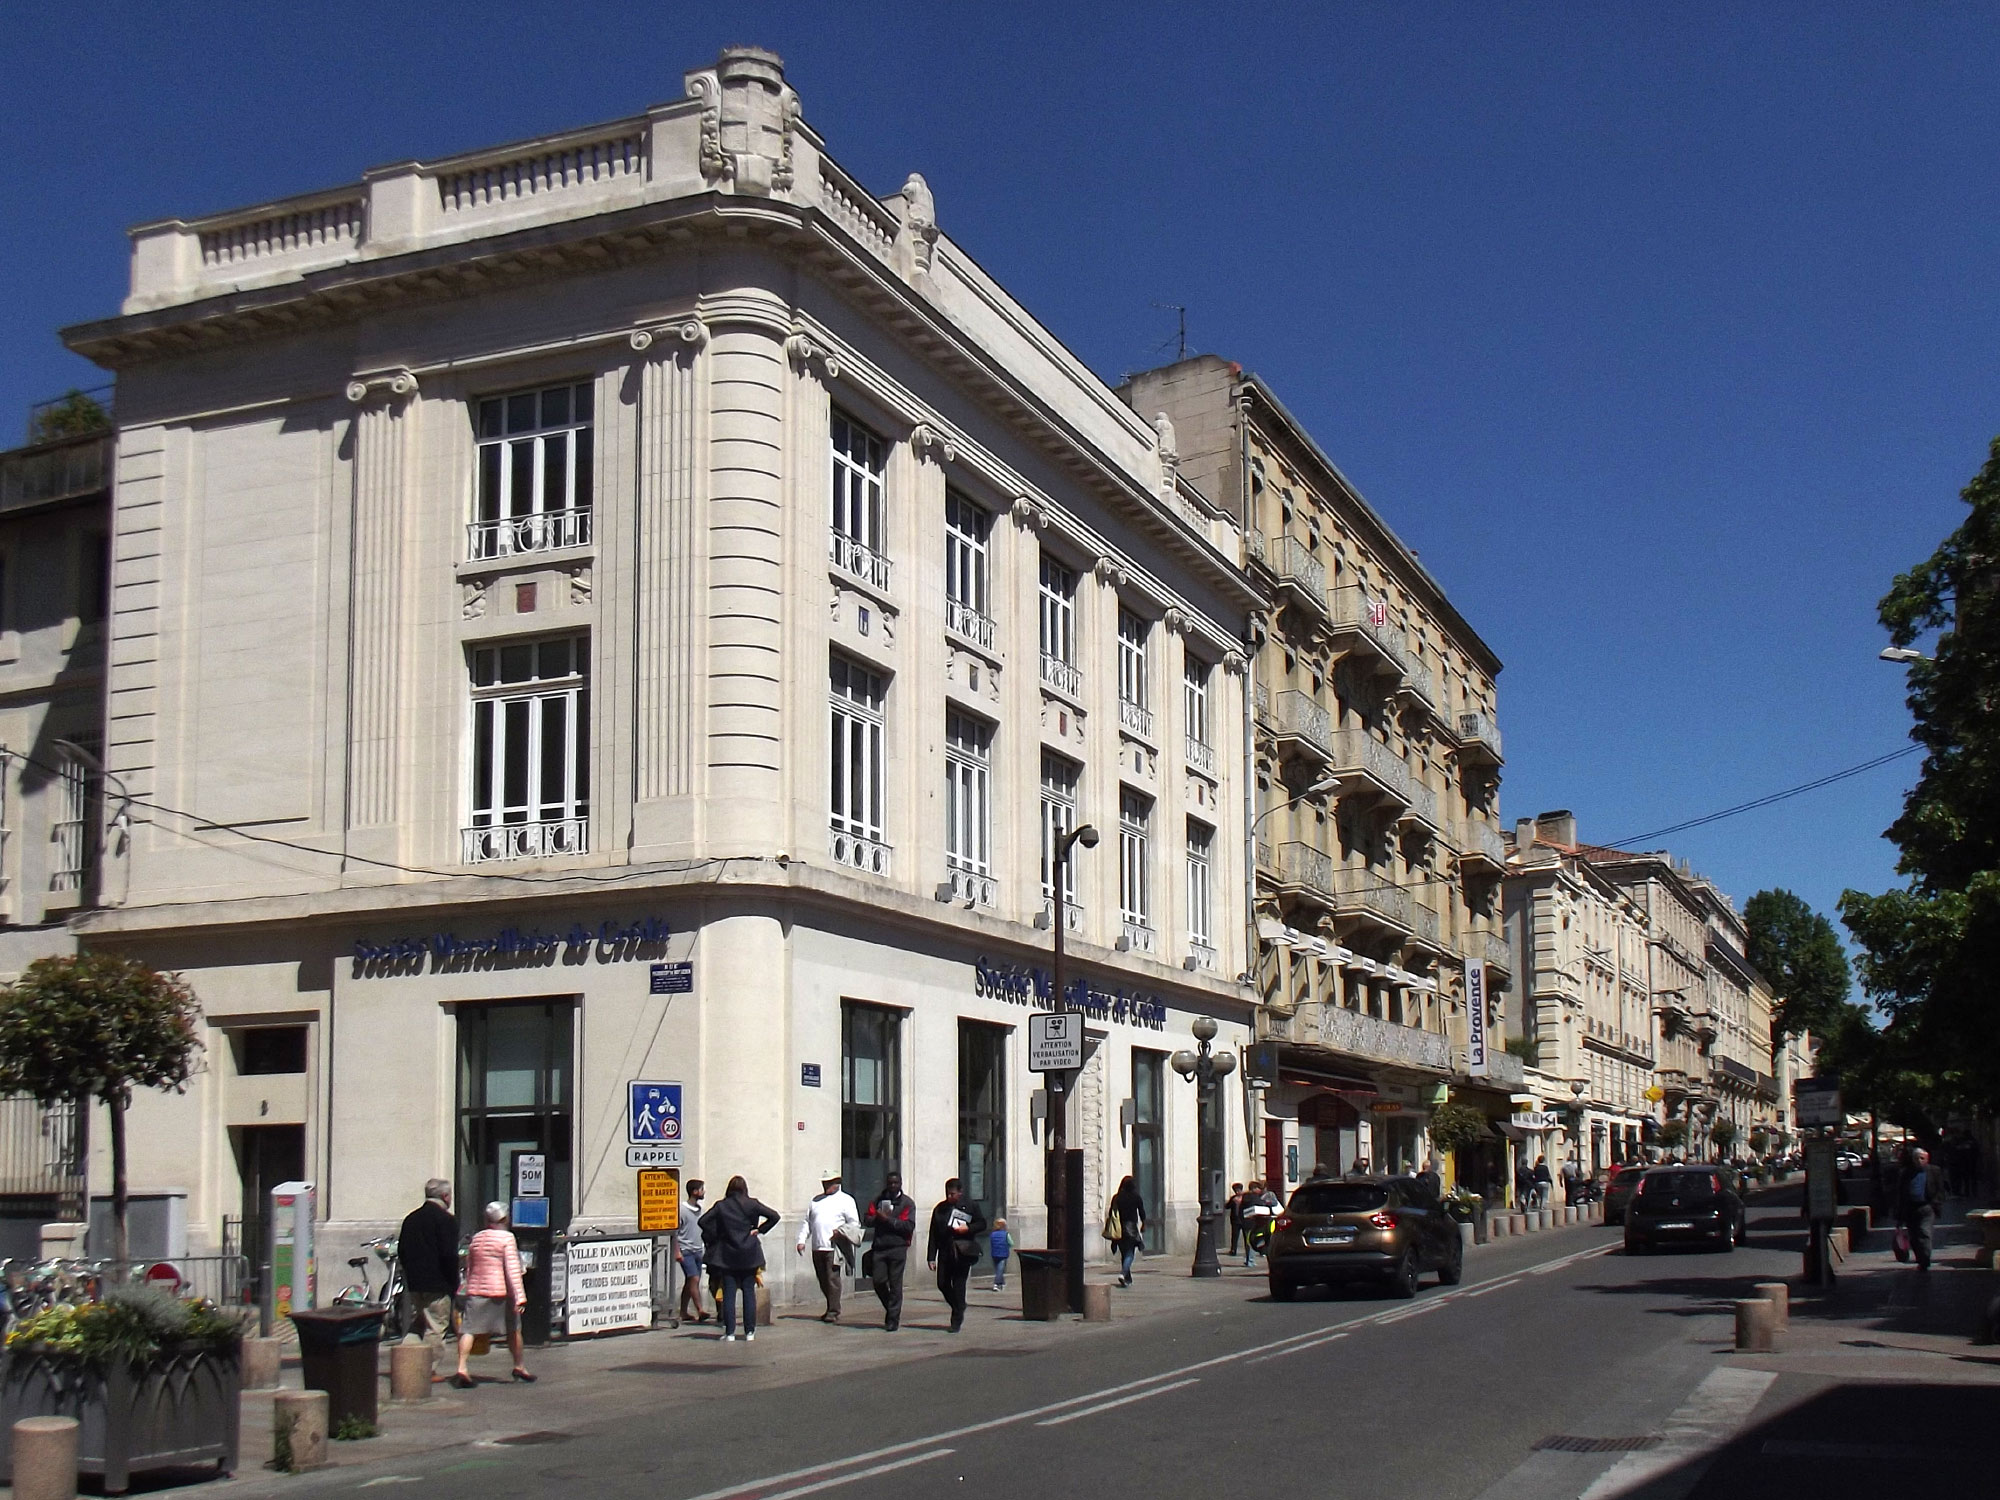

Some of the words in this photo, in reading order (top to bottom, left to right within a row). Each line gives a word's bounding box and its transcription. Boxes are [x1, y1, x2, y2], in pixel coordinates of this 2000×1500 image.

[1470, 968, 1483, 1044] Provence
[1040, 1041, 1072, 1049] ATTENTION
[1032, 1050, 1079, 1059] VERBALISATION
[1472, 1046, 1484, 1066] La
[1053, 1058, 1072, 1066] VIDEO
[665, 1124, 676, 1132] 20
[634, 1151, 678, 1161] RAPPEL
[522, 1170, 542, 1180] 50M
[570, 1264, 599, 1275] OPERATION
[601, 1261, 625, 1272] SECURITE
[627, 1259, 649, 1270] ENFANTS
[581, 1277, 608, 1288] PERIODES
[610, 1275, 638, 1286] SCOLAIRES
[582, 1319, 589, 1327] LA
[590, 1316, 608, 1326] VILLE
